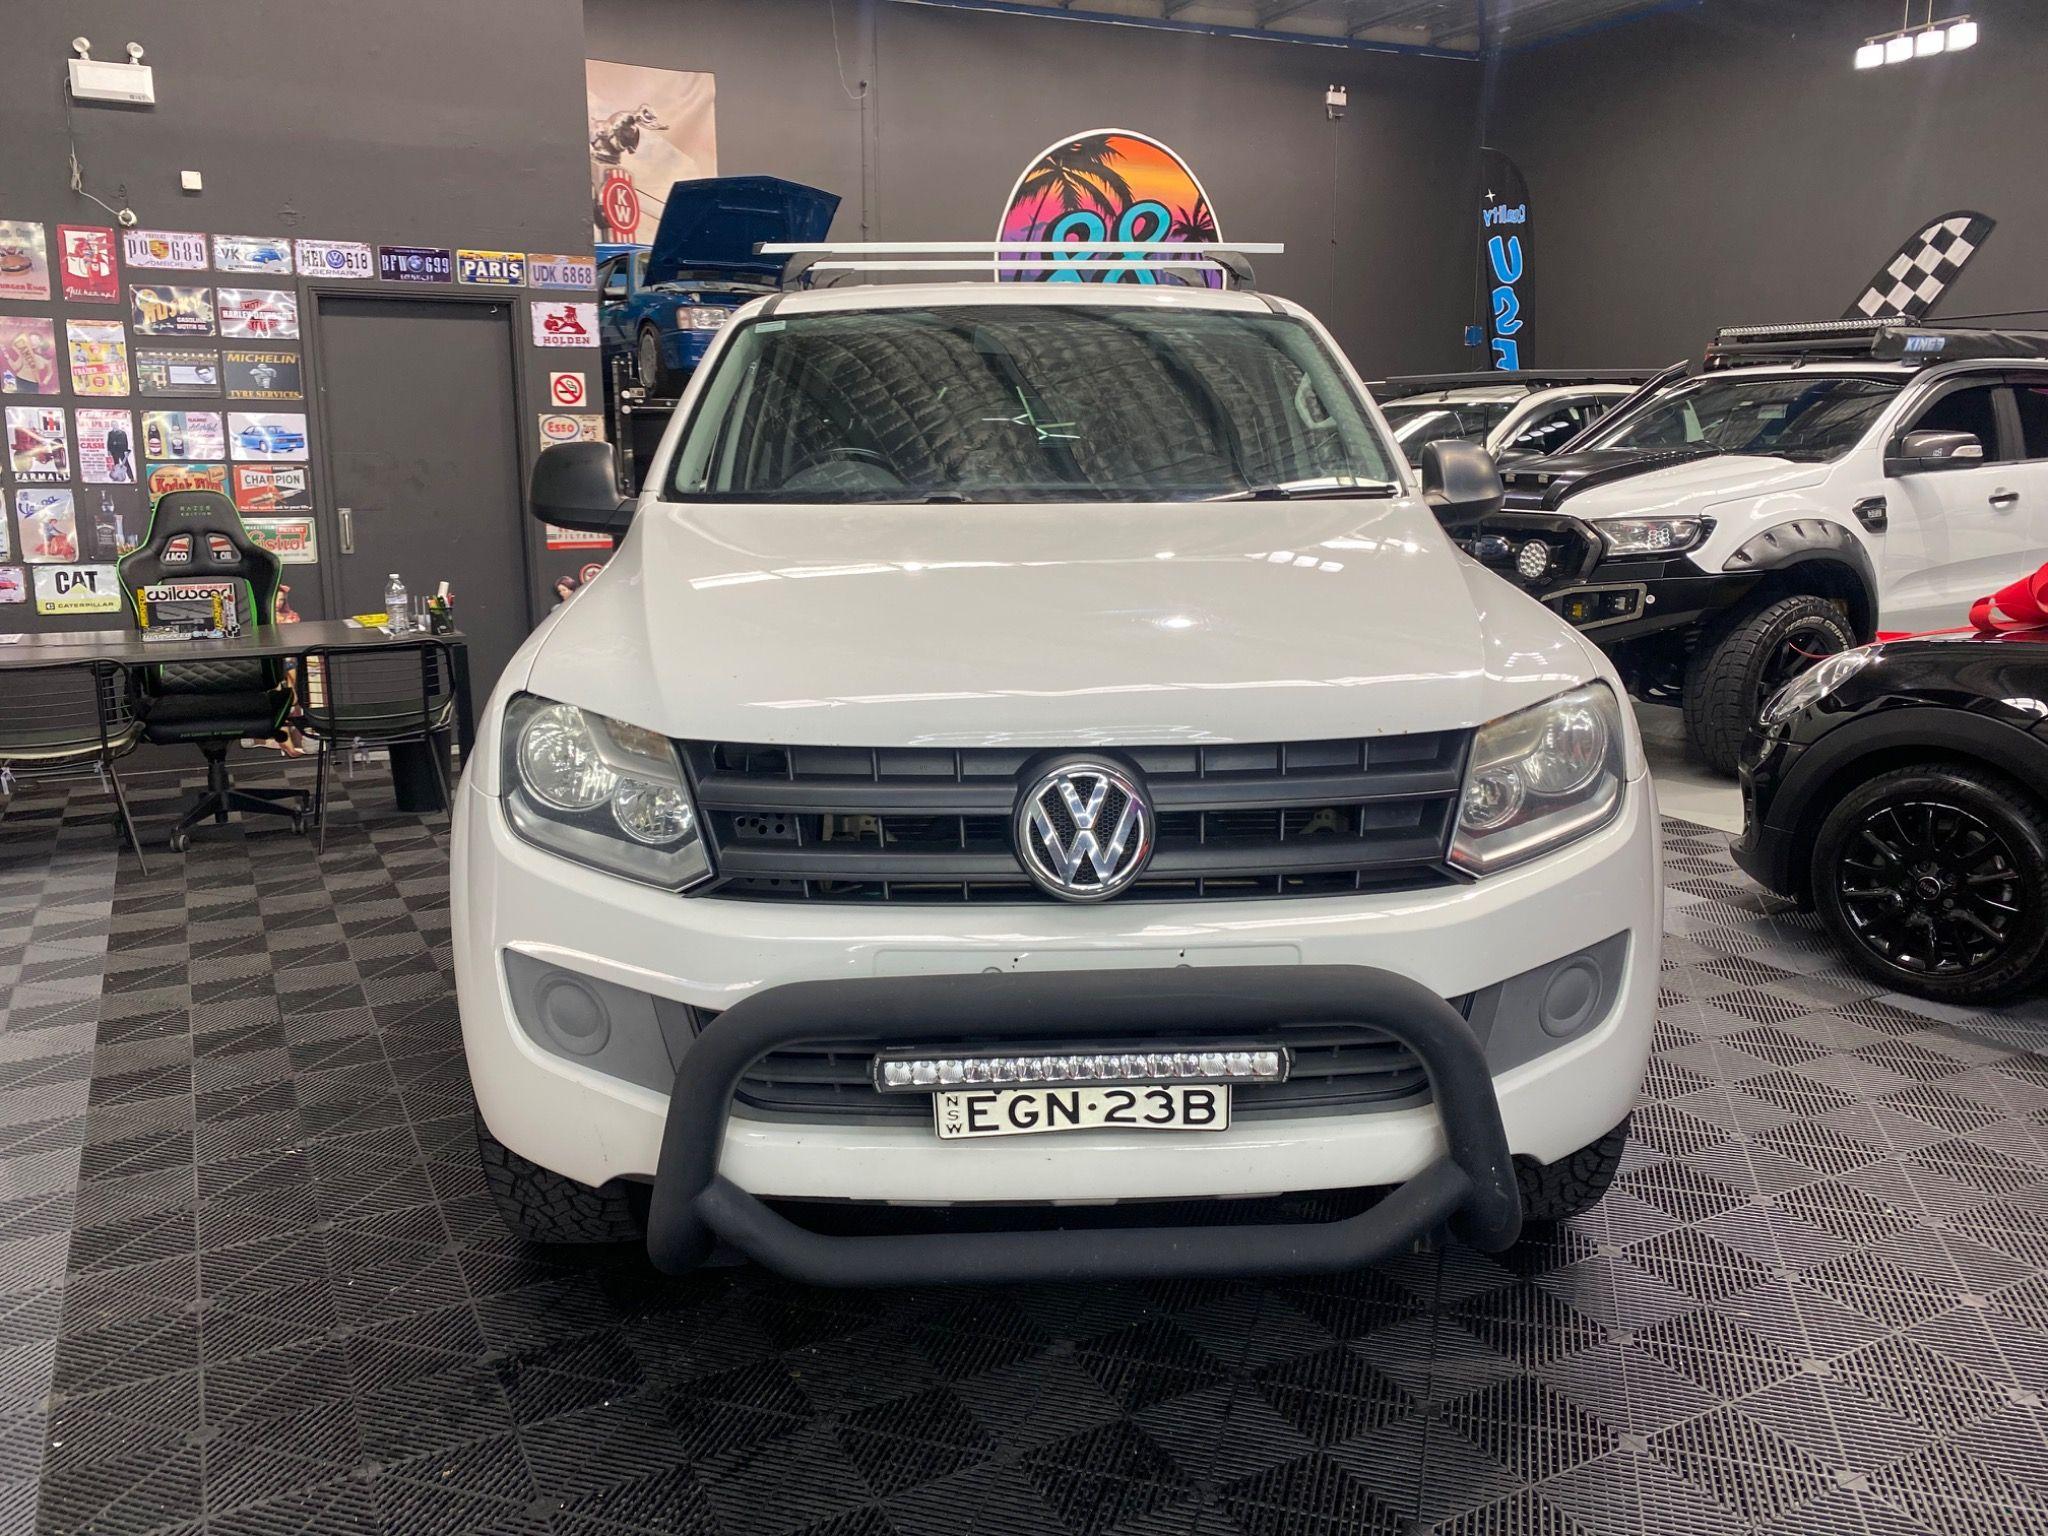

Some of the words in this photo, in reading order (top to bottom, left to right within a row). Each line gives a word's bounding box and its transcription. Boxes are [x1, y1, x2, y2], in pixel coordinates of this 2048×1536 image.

[171, 241, 203, 262] 689
[346, 253, 368, 269] 618
[425, 256, 449, 273] 699
[464, 260, 520, 279] PARIS
[533, 264, 557, 282] UDK
[562, 266, 592, 284] 6868
[543, 336, 590, 345] HOLDEN
[227, 353, 297, 363] MICHELIN
[230, 390, 253, 398] TYRE
[254, 390, 300, 399] SERVICES
[15, 472, 70, 481] FARMALL
[245, 474, 300, 485] CHAMPION
[55, 571, 98, 594] CAT
